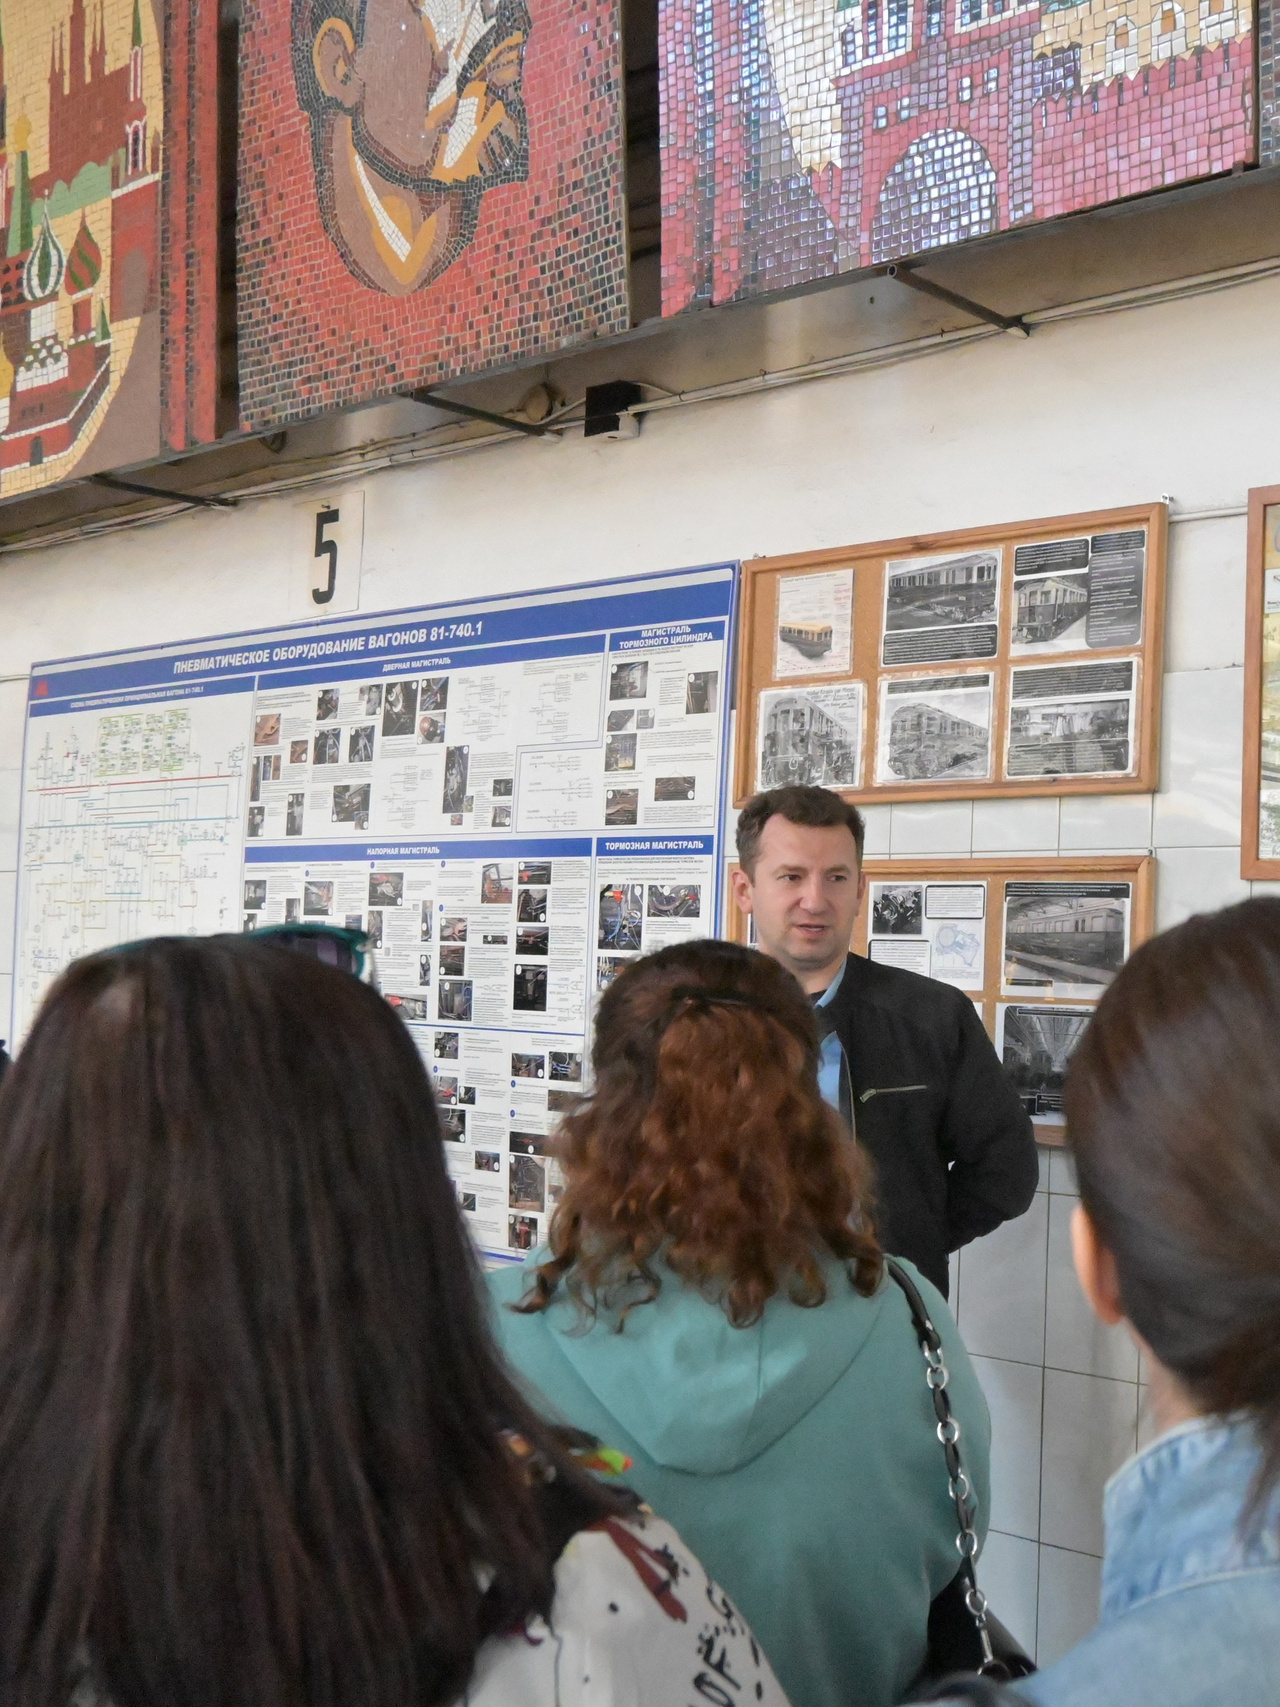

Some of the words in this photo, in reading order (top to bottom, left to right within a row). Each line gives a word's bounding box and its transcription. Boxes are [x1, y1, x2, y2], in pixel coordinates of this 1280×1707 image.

[312, 508, 339, 605] 5
[641, 625, 691, 638] МАГИСТРАЛЬ
[173, 649, 271, 674] ПНЕВМАТИЧЕСКОЕ
[272, 636, 366, 661] ОБОРУДОВАНИЕ
[368, 628, 427, 649] ВАГОНОВ
[429, 620, 483, 641] 81-740.1
[619, 637, 669, 650] ТОРМОЗНОГО
[670, 631, 713, 645] ЦИЛИНДРА
[382, 661, 411, 673] ДВЕРНАЯ
[411, 656, 452, 669] МАГИСТРАЛЬ
[366, 847, 399, 856] НАПОРНАЯ
[399, 846, 441, 855] МАГИСТРАЛЬ
[605, 841, 650, 850] ТОРМОЗНАЯ
[651, 840, 704, 850] МАГИСТРАЛЬ
